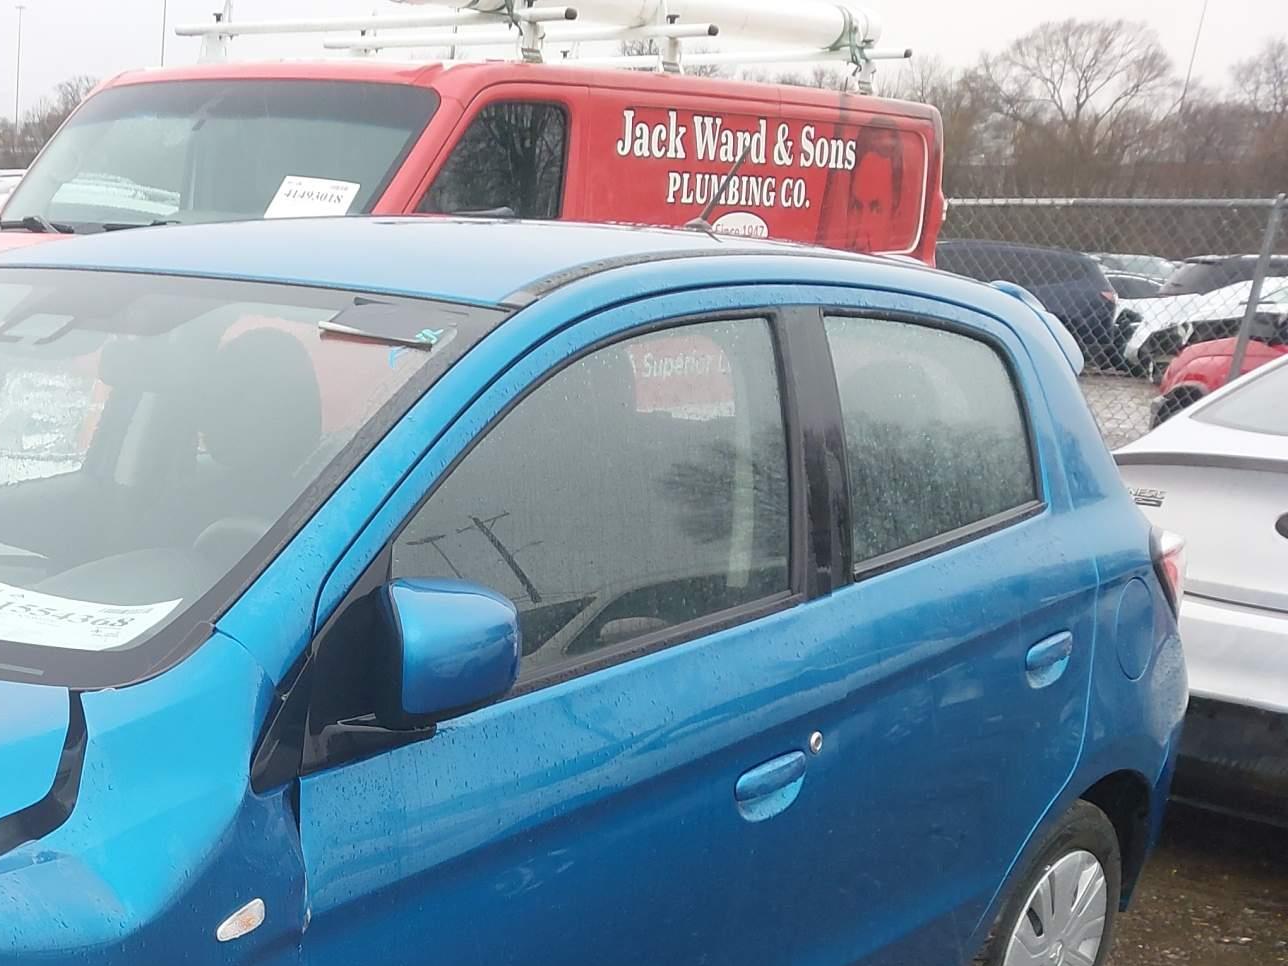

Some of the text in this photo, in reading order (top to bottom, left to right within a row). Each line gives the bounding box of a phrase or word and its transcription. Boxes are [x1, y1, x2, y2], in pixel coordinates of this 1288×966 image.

[616, 109, 857, 170] Jack Ward & Sons
[666, 171, 810, 209] PLUMBING CO.
